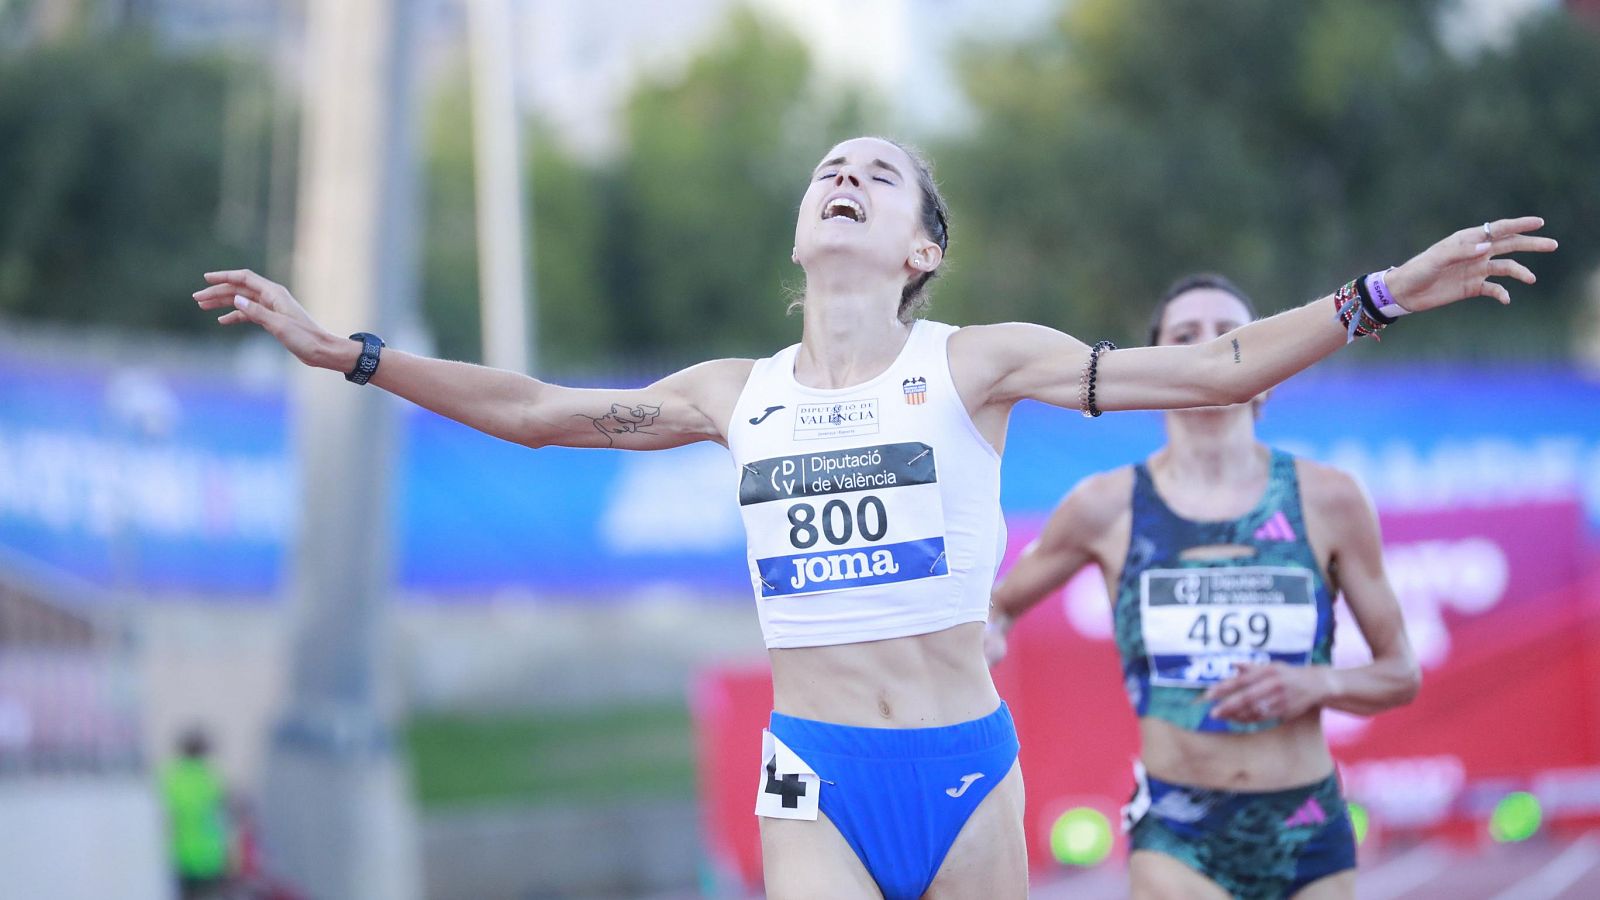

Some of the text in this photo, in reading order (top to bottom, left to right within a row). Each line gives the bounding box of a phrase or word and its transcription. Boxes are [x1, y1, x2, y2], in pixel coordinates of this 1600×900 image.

[811, 449, 882, 474] Diputació
[811, 470, 897, 492] de València
[787, 495, 888, 549] 800
[1188, 612, 1272, 648] 469
